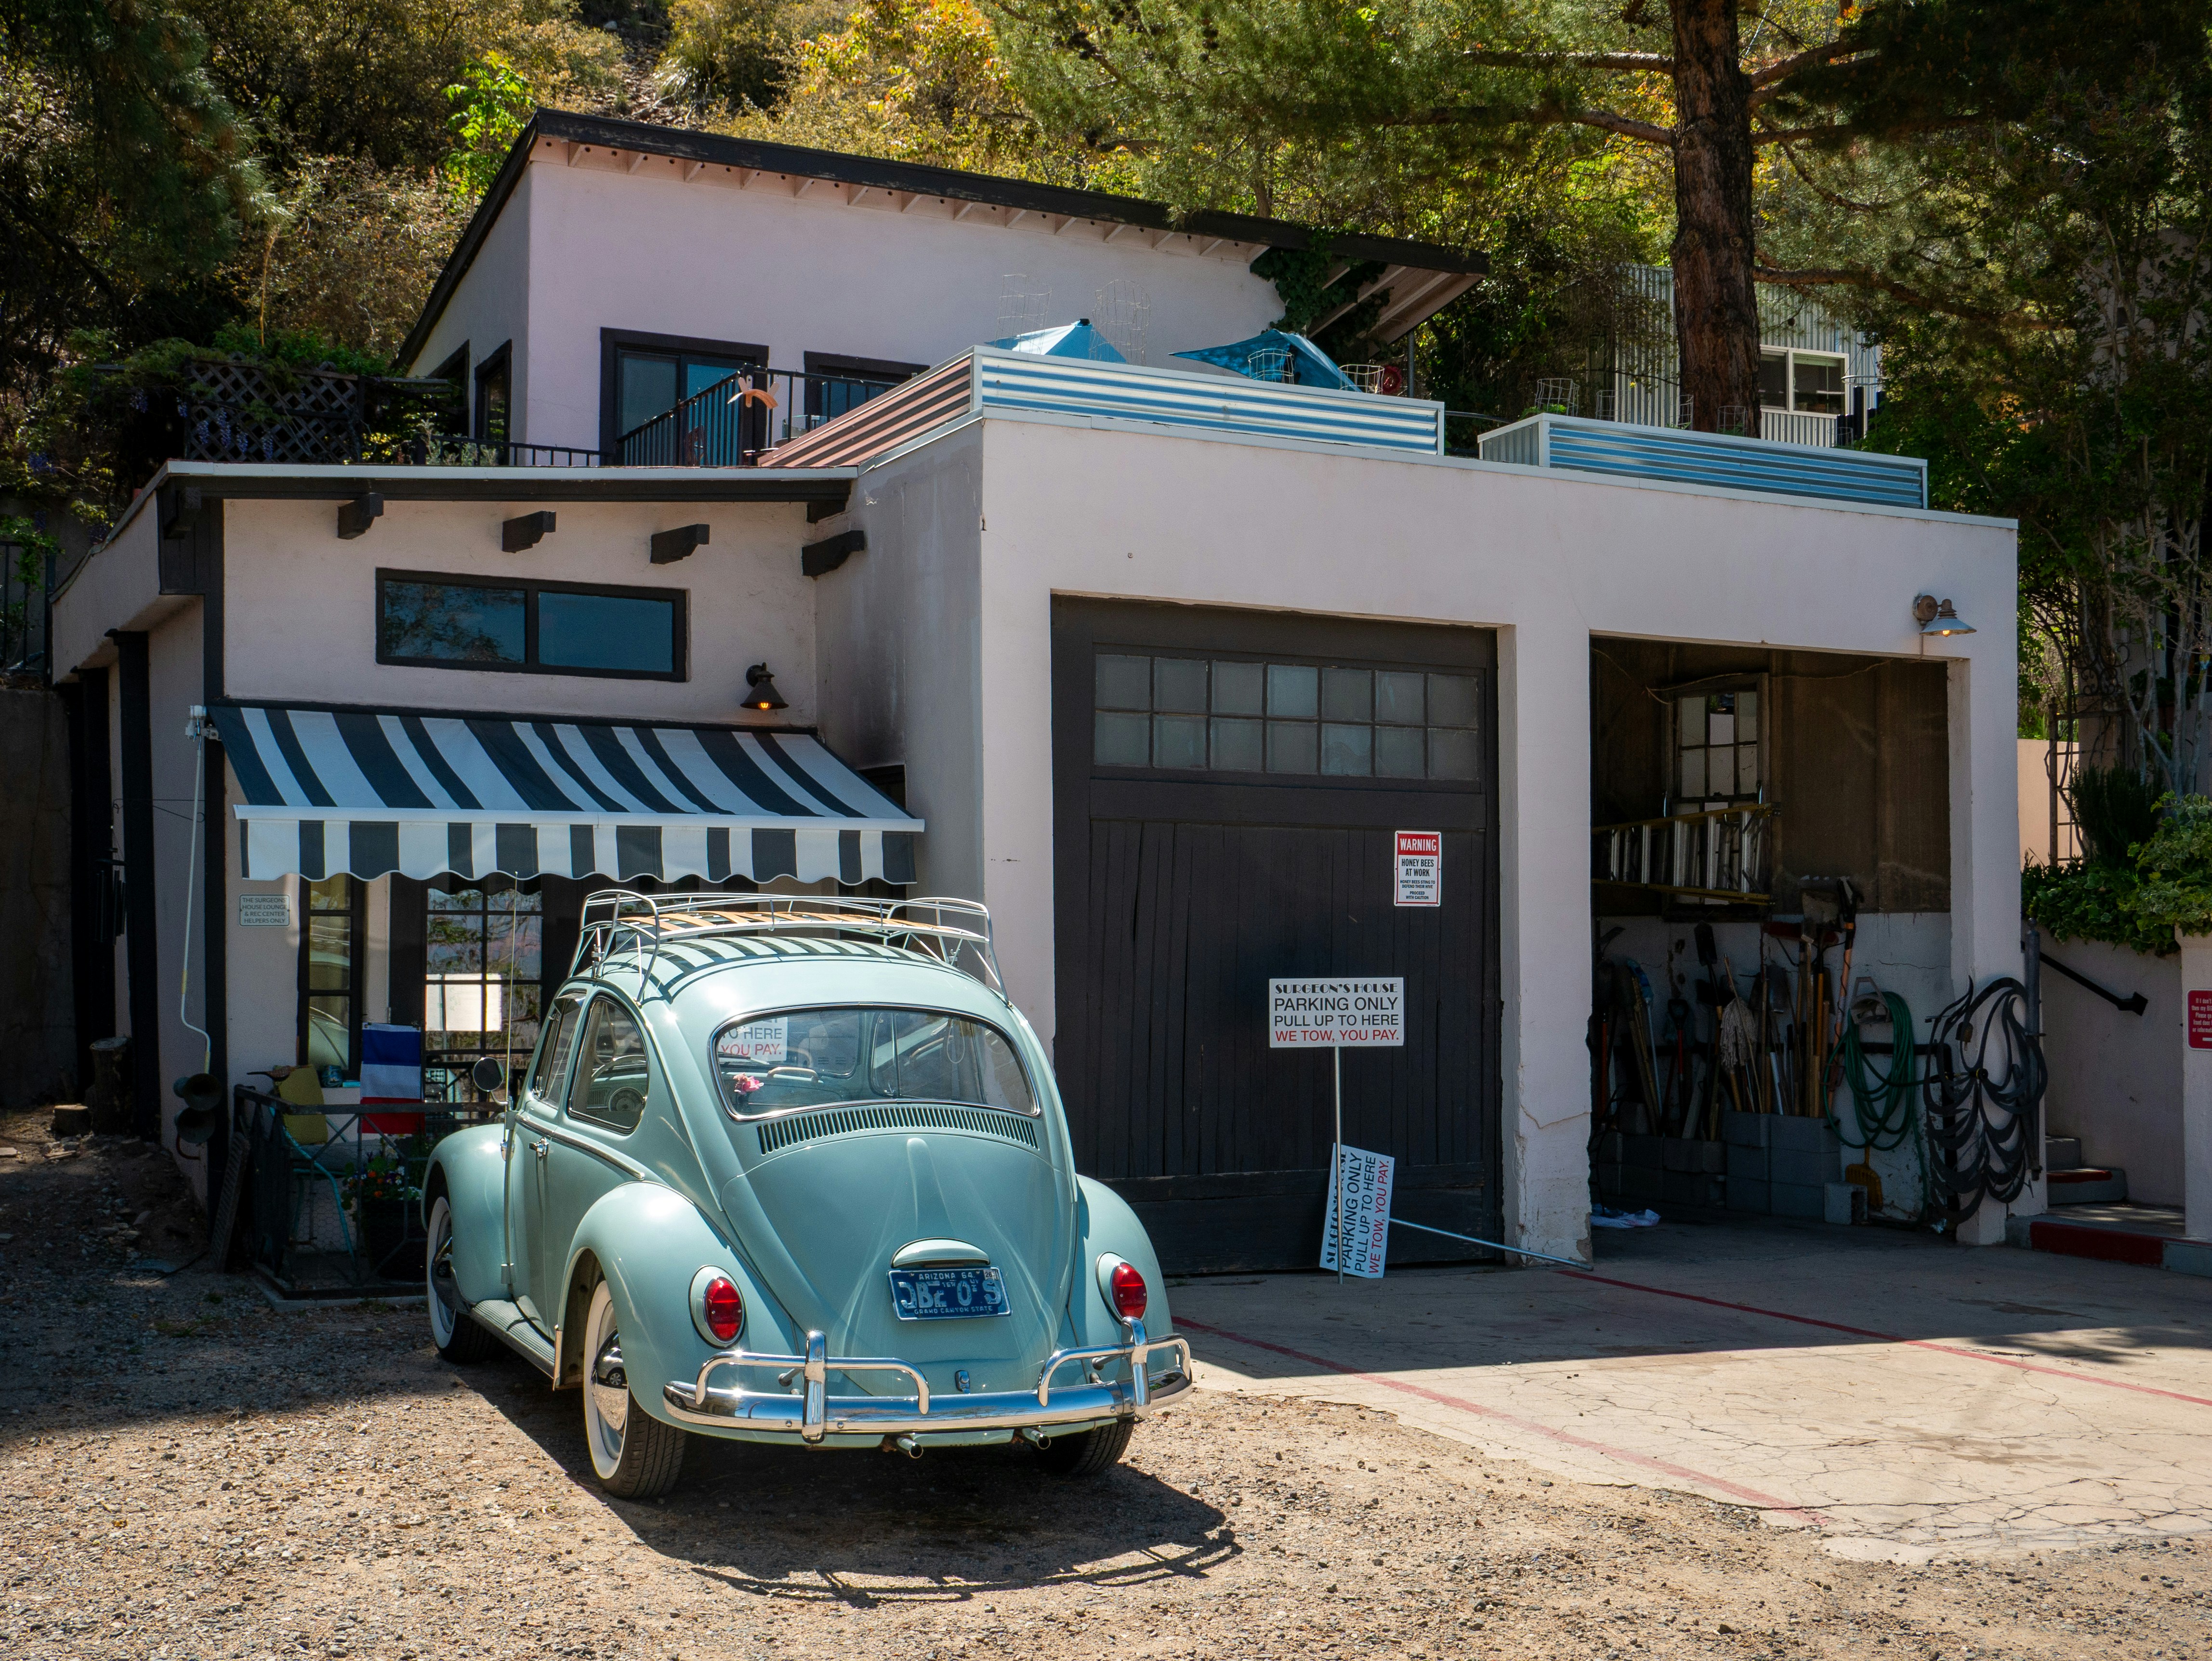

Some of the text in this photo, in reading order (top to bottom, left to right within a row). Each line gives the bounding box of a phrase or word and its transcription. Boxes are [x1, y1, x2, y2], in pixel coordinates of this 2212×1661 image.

[1400, 838, 1436, 851] WARNING
[1402, 858, 1434, 867] HONEY BEES
[1275, 983, 1397, 994] SURGEON'S HOUSE
[1275, 997, 1398, 1011] PARKING ONLY
[1275, 1014, 1399, 1027] PULL UP TO HERE
[744, 1027, 782, 1039] HERE
[1275, 1029, 1399, 1042] WE TOW, YOU PAY.
[721, 1043, 782, 1056] YOU PAY.
[1342, 1152, 1362, 1269] PARKING ONLY
[1355, 1155, 1376, 1272] PULL UP TO HERE
[1369, 1160, 1389, 1274] WE TOW, YOU PAY.
